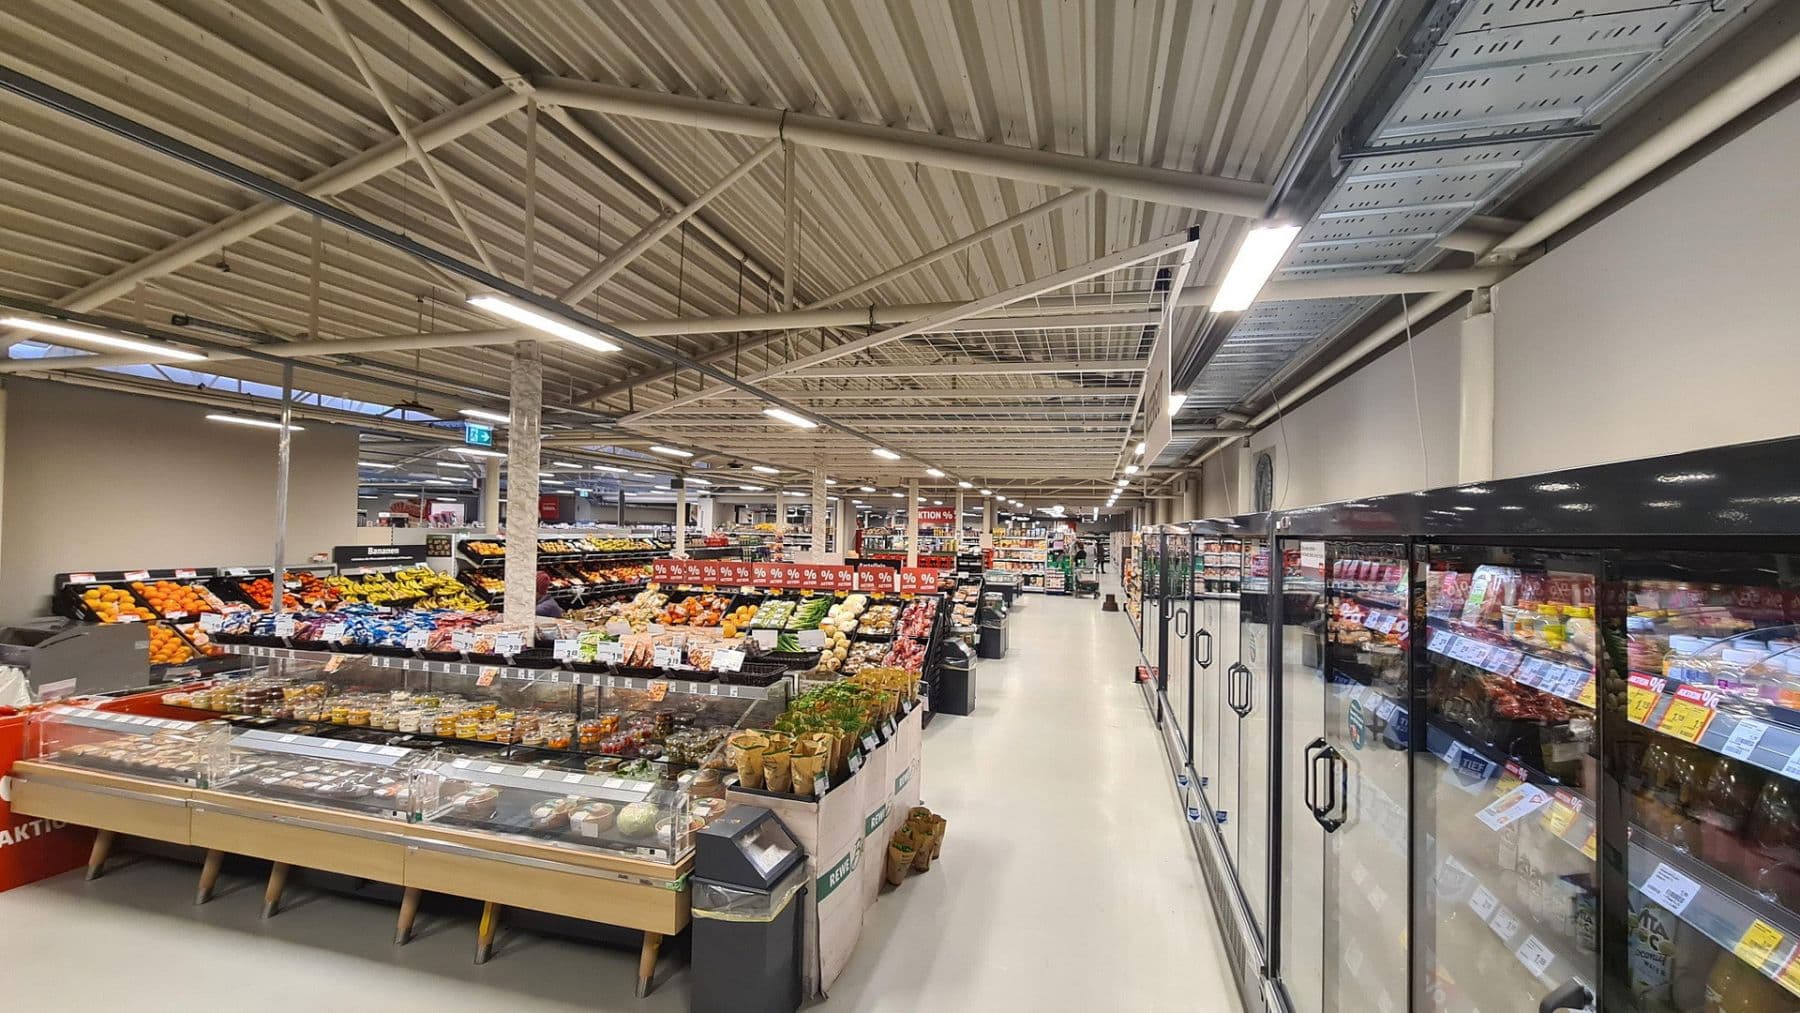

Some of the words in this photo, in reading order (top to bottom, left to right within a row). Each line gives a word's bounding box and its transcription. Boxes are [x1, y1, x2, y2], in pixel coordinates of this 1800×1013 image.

[919, 511, 942, 520] KTION
[942, 511, 953, 520] %
[655, 564, 667, 574] %
[671, 565, 682, 575] %
[688, 565, 700, 576] %
[704, 565, 716, 576] %
[720, 566, 733, 577] %
[737, 566, 749, 577] %
[754, 567, 766, 578] %
[771, 568, 783, 578] %
[787, 569, 800, 579] %
[804, 569, 817, 580] %
[821, 569, 834, 580] %
[838, 570, 851, 581] %
[861, 571, 874, 582] %
[878, 571, 892, 583] %
[903, 572, 916, 583] %
[921, 573, 935, 584] %
[1649, 677, 1666, 693] %
[1702, 690, 1719, 708] %
[1462, 758, 1485, 771] TIEF
[1519, 767, 1528, 781] %
[1571, 797, 1583, 812] %
[0, 819, 66, 848] AKTIO
[829, 858, 850, 887] REWE
[1635, 948, 1666, 966] OCONUT
